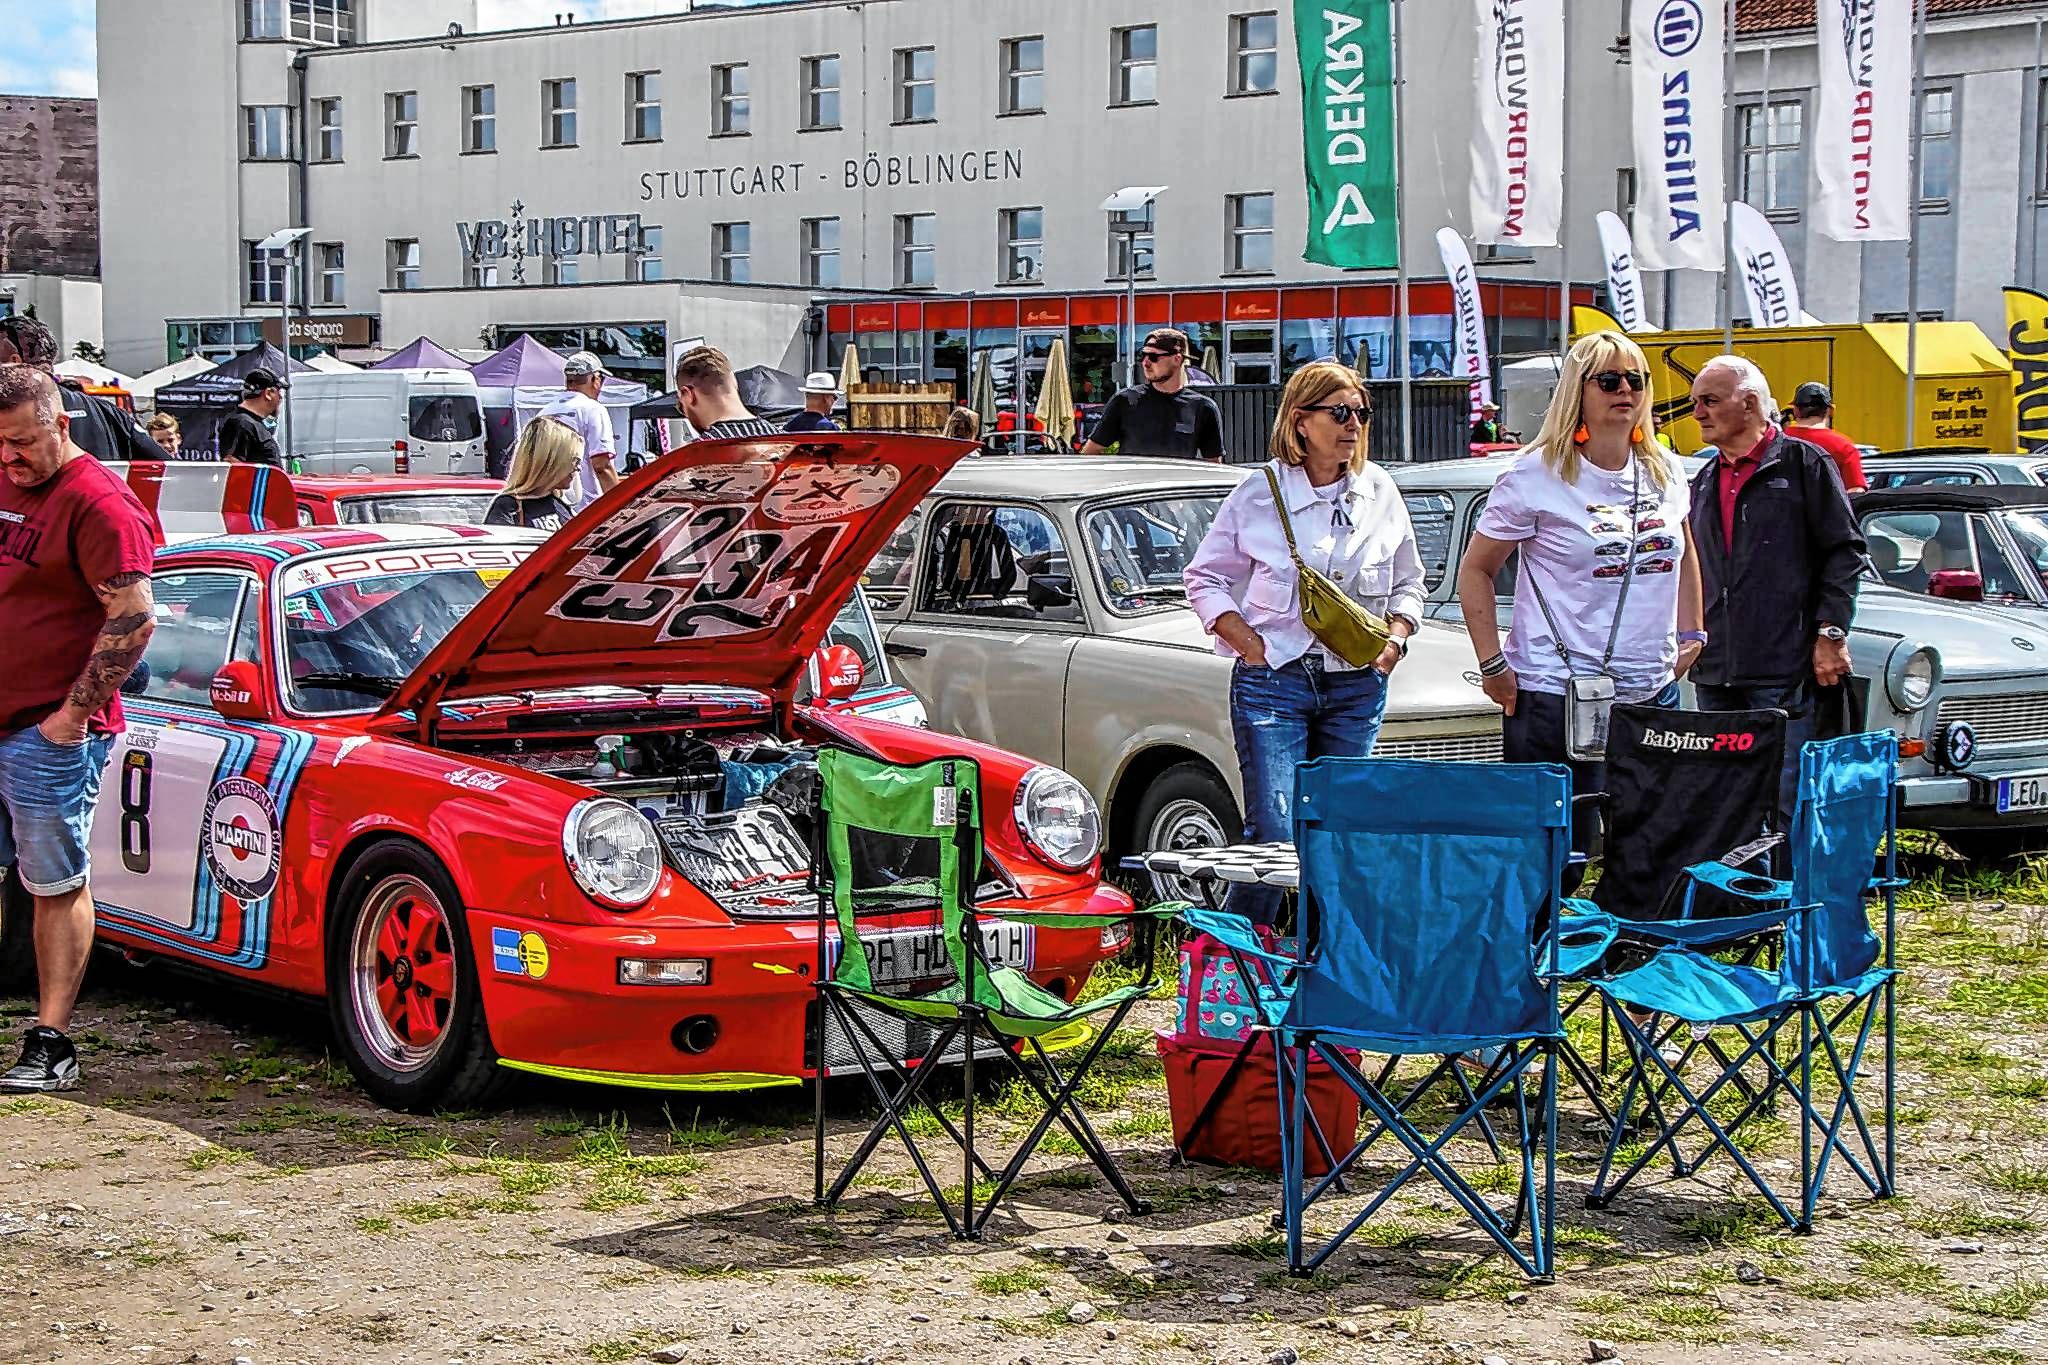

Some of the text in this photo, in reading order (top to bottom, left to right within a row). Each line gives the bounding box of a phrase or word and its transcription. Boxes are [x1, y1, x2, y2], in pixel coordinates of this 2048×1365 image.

[640, 163, 804, 201] STUTTGART
[844, 148, 1023, 188] BÖBLINGEN
[456, 213, 654, 260] V8 HOTEL
[121, 750, 153, 874] 8
[2010, 780, 2039, 807] LEO
[215, 824, 266, 855] MARTINI
